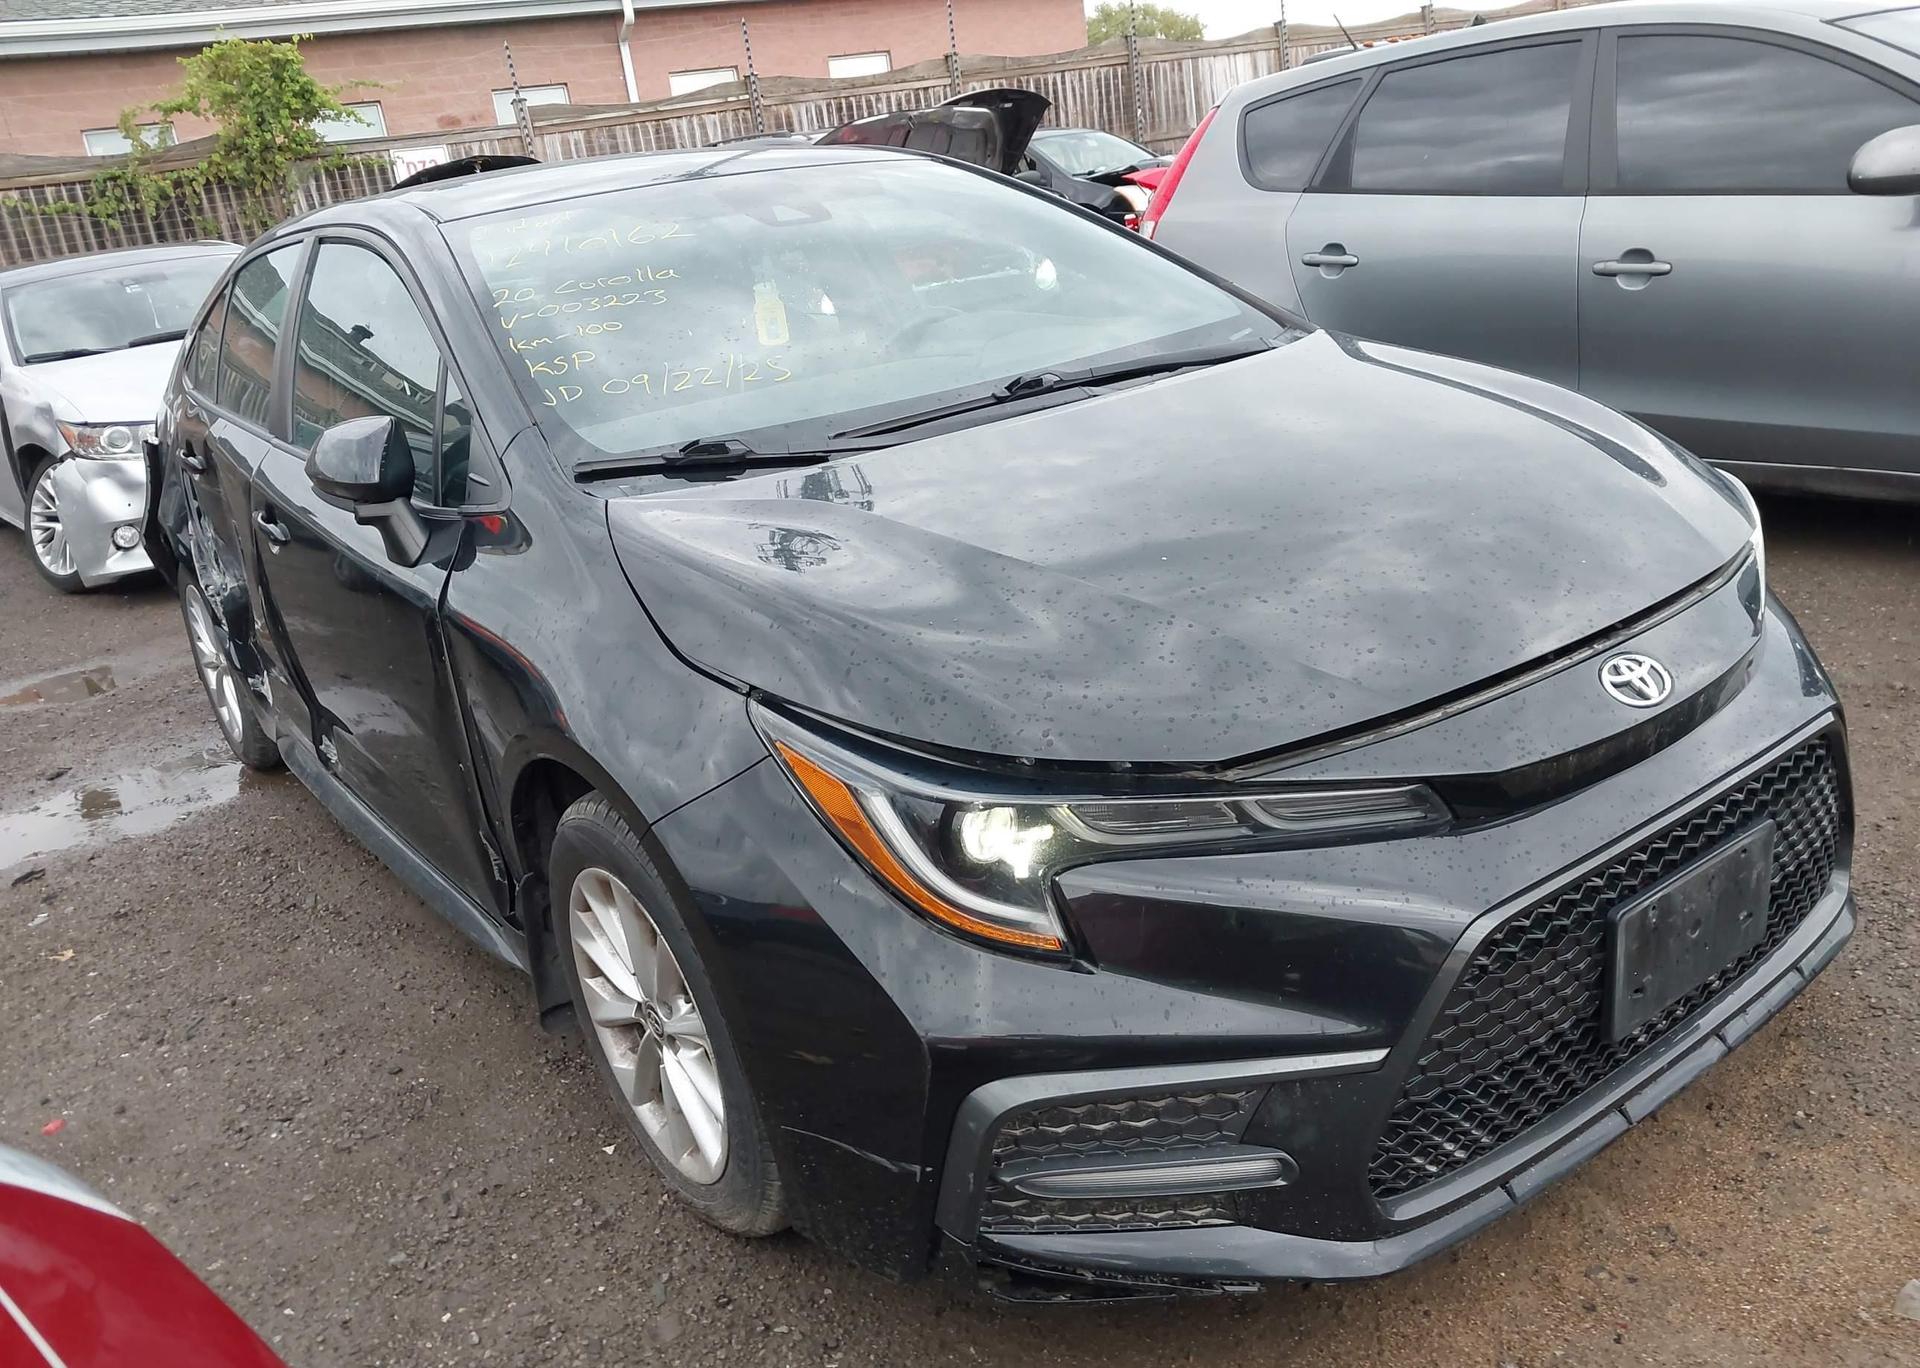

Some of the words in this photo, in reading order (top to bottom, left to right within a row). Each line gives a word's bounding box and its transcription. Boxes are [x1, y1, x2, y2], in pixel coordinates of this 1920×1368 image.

[493, 287, 535, 308] 20
[501, 290, 667, 329] V-003223
[525, 350, 596, 378] KSP
[541, 385, 583, 406] JD
[602, 353, 792, 395] 09/22/25
